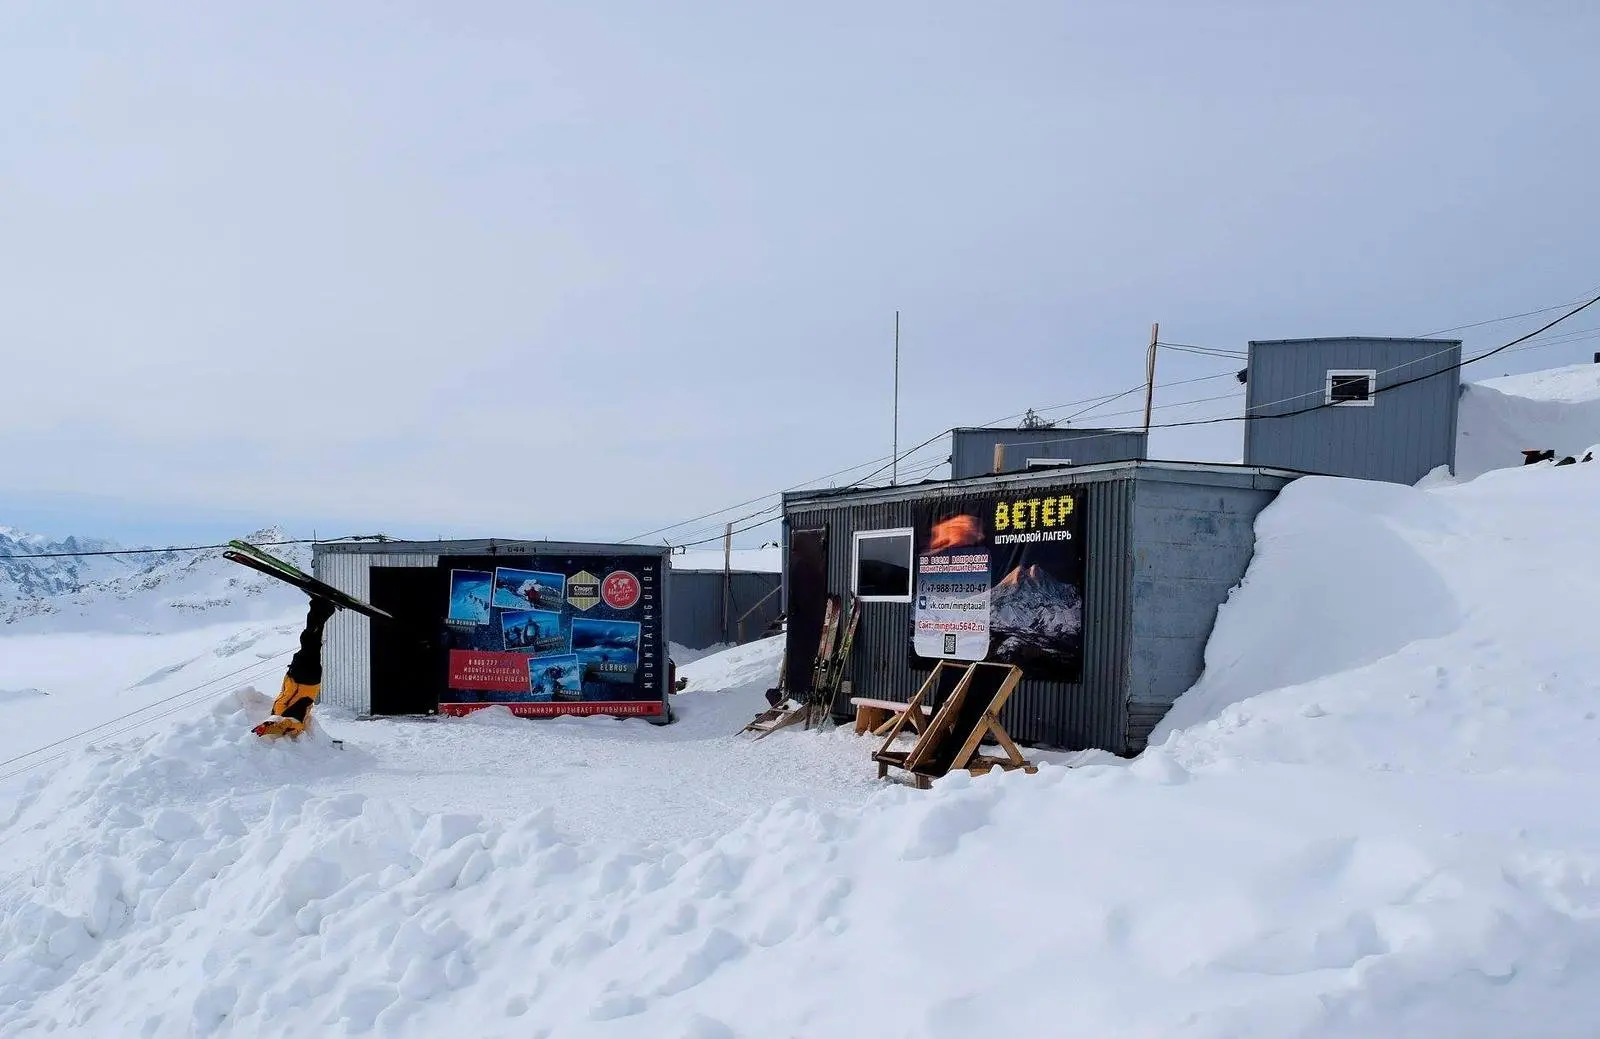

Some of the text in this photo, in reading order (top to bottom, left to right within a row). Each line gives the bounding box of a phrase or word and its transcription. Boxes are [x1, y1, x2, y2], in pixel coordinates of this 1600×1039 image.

[995, 495, 1073, 530] ВЕТЕР
[995, 530, 1072, 544] ШТУРМОВОЙ ЛАГЕРЬ
[926, 583, 987, 593] +7-988-723-20-47
[643, 565, 653, 689] MOUNTAINGUIDE
[600, 663, 628, 672] ELBRUS
